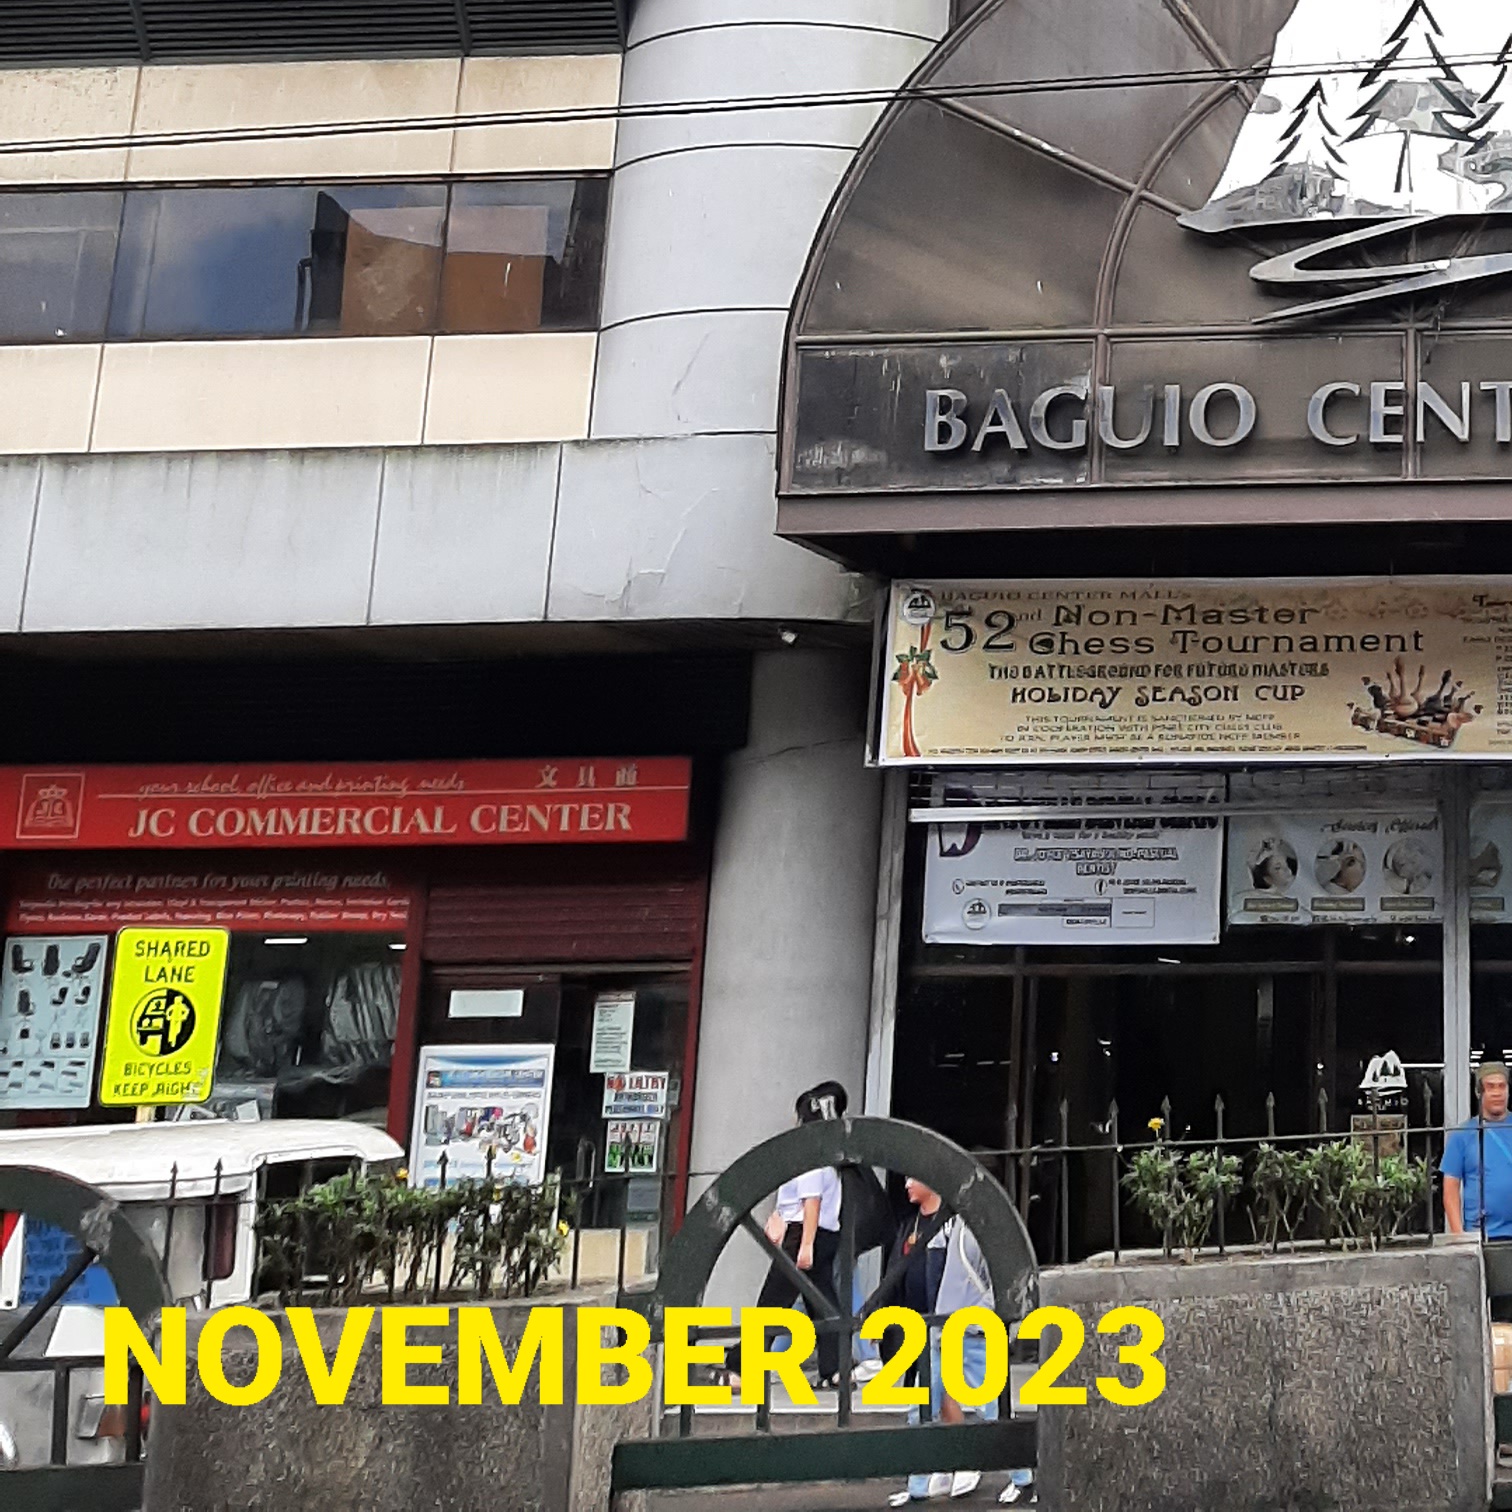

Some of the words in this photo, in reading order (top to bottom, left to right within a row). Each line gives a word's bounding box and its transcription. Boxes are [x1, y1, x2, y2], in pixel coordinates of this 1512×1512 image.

[923, 380, 1257, 453] BAGUIO
[939, 590, 1021, 601] BAGUIO
[1028, 589, 1113, 601] CENTER
[1052, 602, 1321, 626] Non-Master
[1028, 631, 1156, 655] Chess
[1169, 629, 1425, 654] Tournament
[1154, 663, 1183, 678] FOR
[1010, 685, 1122, 709] HOLIDAY
[1134, 684, 1239, 707] SEASON
[1254, 684, 1306, 702] CUP
[127, 808, 176, 838] JC
[186, 804, 457, 837] COMMERCIAL
[469, 801, 633, 833] CENTER
[203, 873, 227, 889] for
[134, 939, 211, 958] SHARED
[144, 965, 196, 984] LANE
[123, 1061, 192, 1076] BICYCLES
[113, 1082, 149, 1097] KEEP
